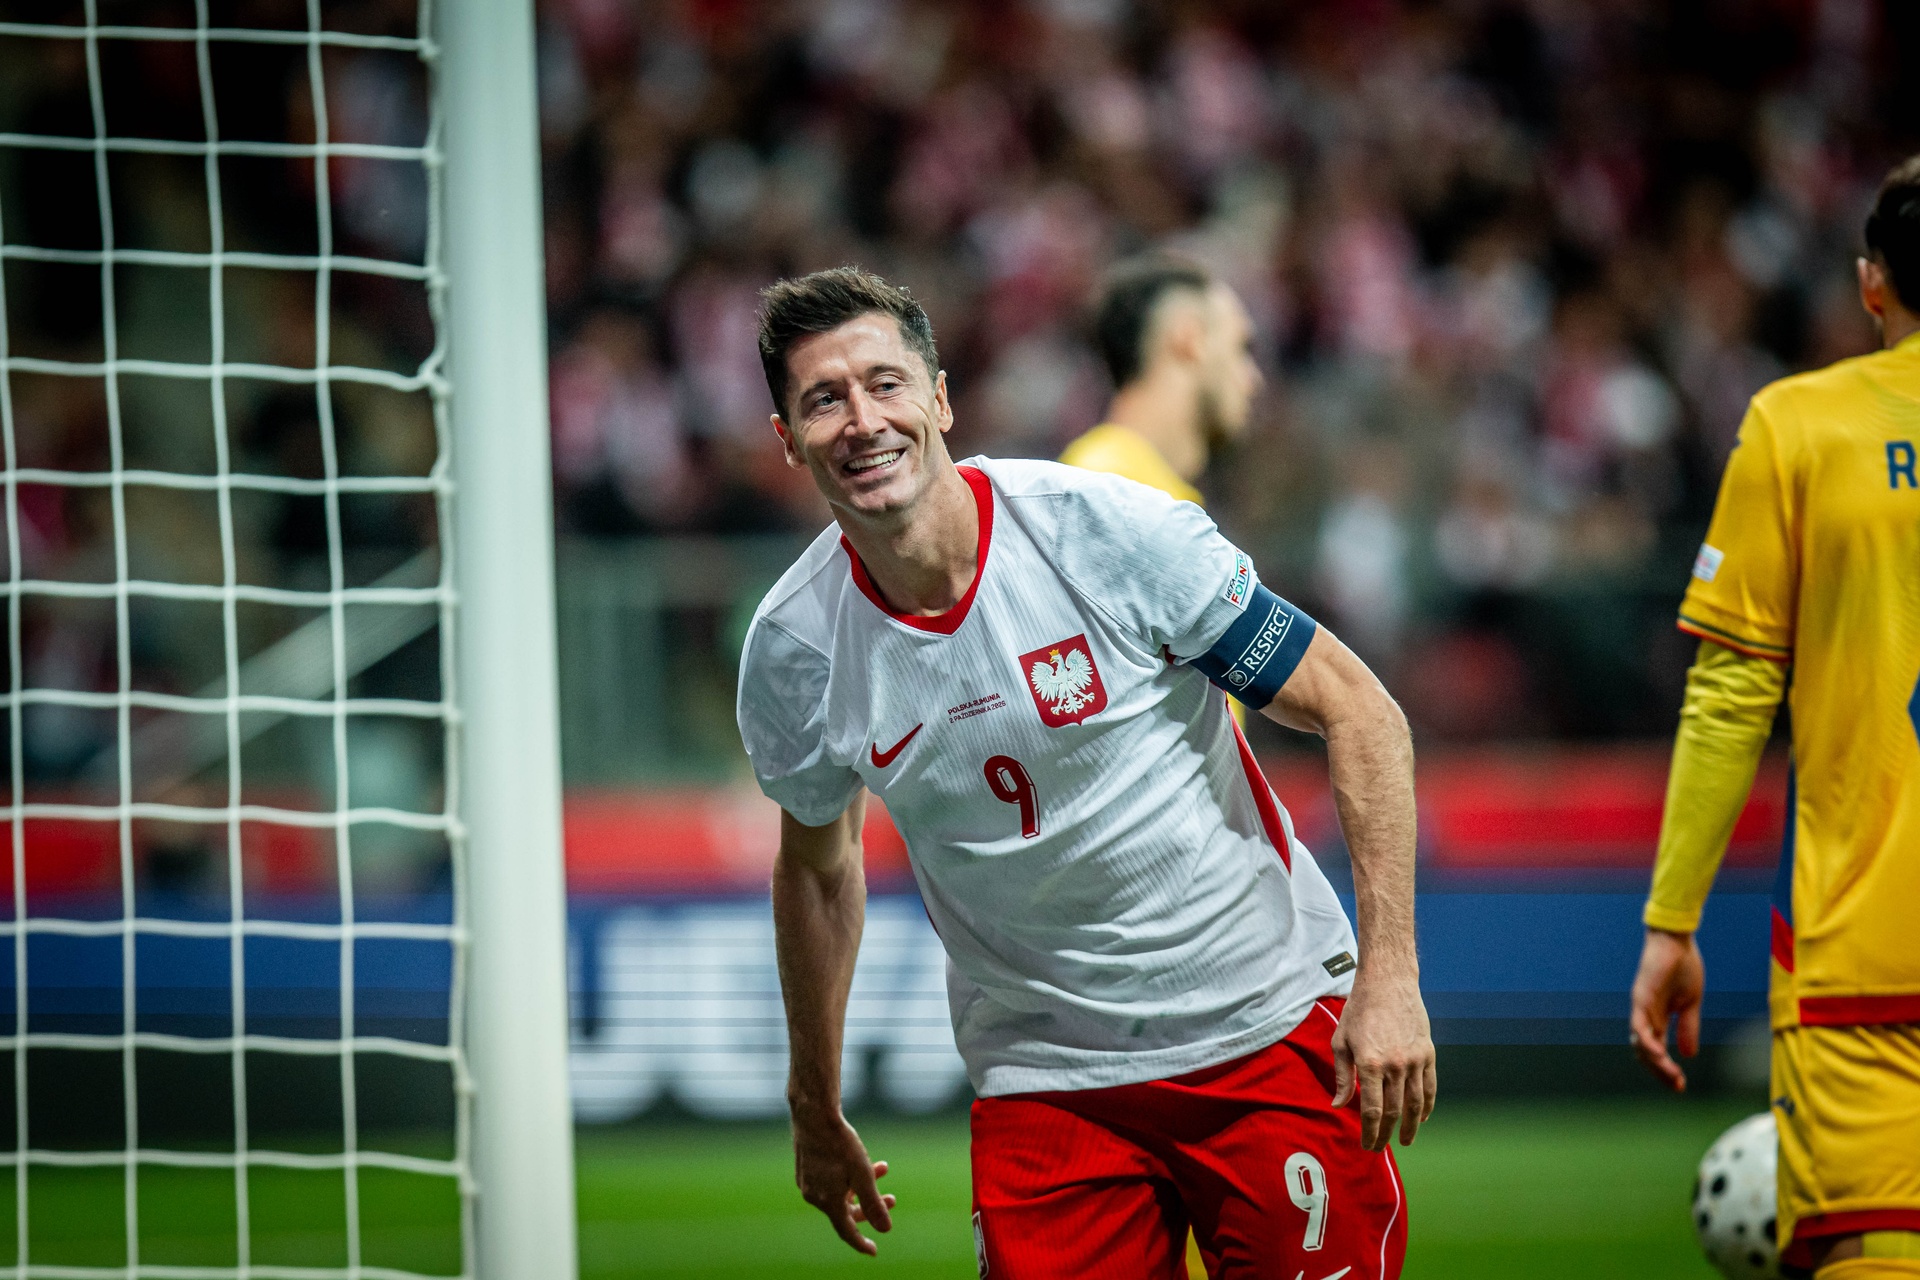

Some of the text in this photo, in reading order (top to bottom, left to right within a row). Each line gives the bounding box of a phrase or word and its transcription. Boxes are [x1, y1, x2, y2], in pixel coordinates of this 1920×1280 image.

[1225, 578, 1237, 598] UEFA
[1243, 605, 1289, 670] RESPECT
[947, 692, 1001, 715] POLSKA-RUMUNIA
[983, 754, 1041, 840] 9
[1284, 1152, 1330, 1252] 9
